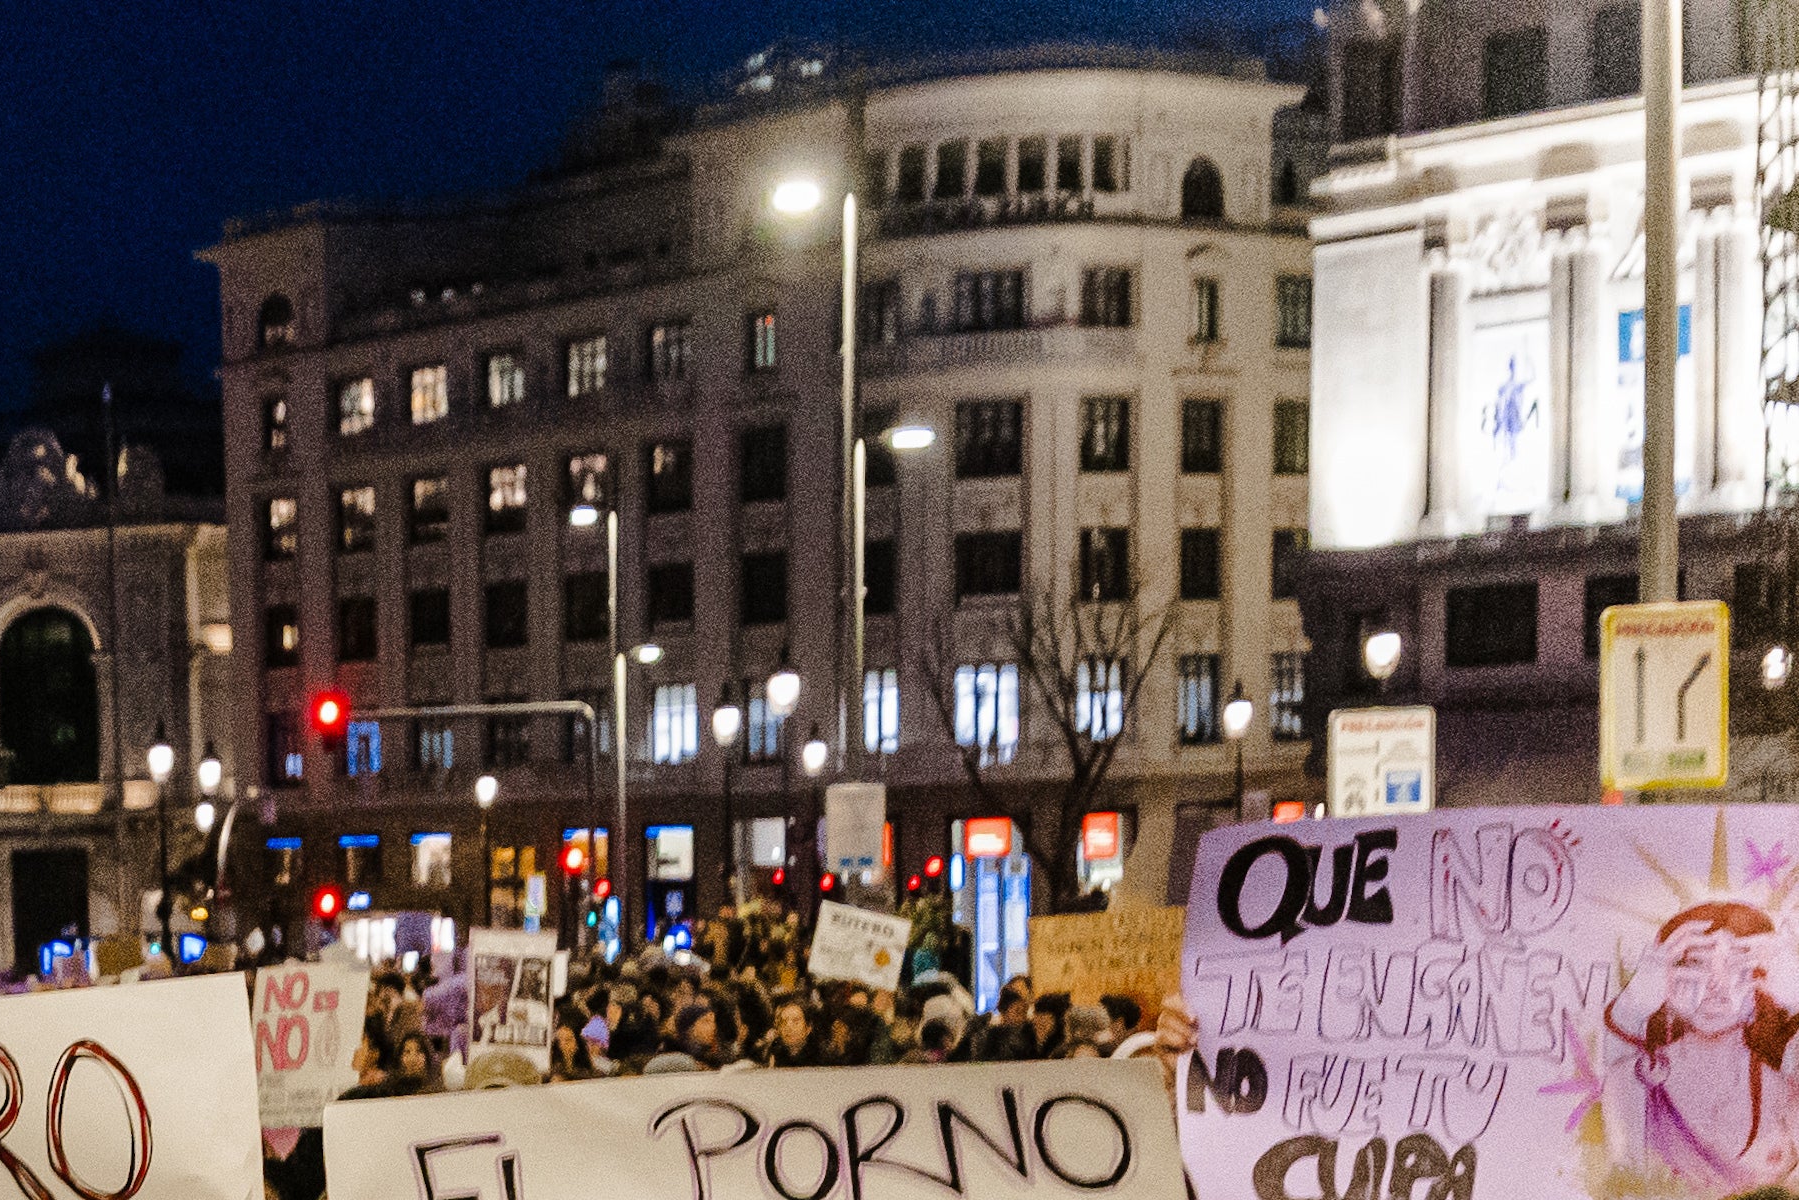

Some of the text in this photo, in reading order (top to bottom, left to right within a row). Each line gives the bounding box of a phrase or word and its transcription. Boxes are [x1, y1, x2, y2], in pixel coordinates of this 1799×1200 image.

[1217, 822, 1578, 946] QUE NO
[262, 970, 311, 1014] NO
[1195, 946, 1310, 1038] TE
[255, 1014, 311, 1075] NO
[1185, 1046, 1509, 1142] NO FUE TU
